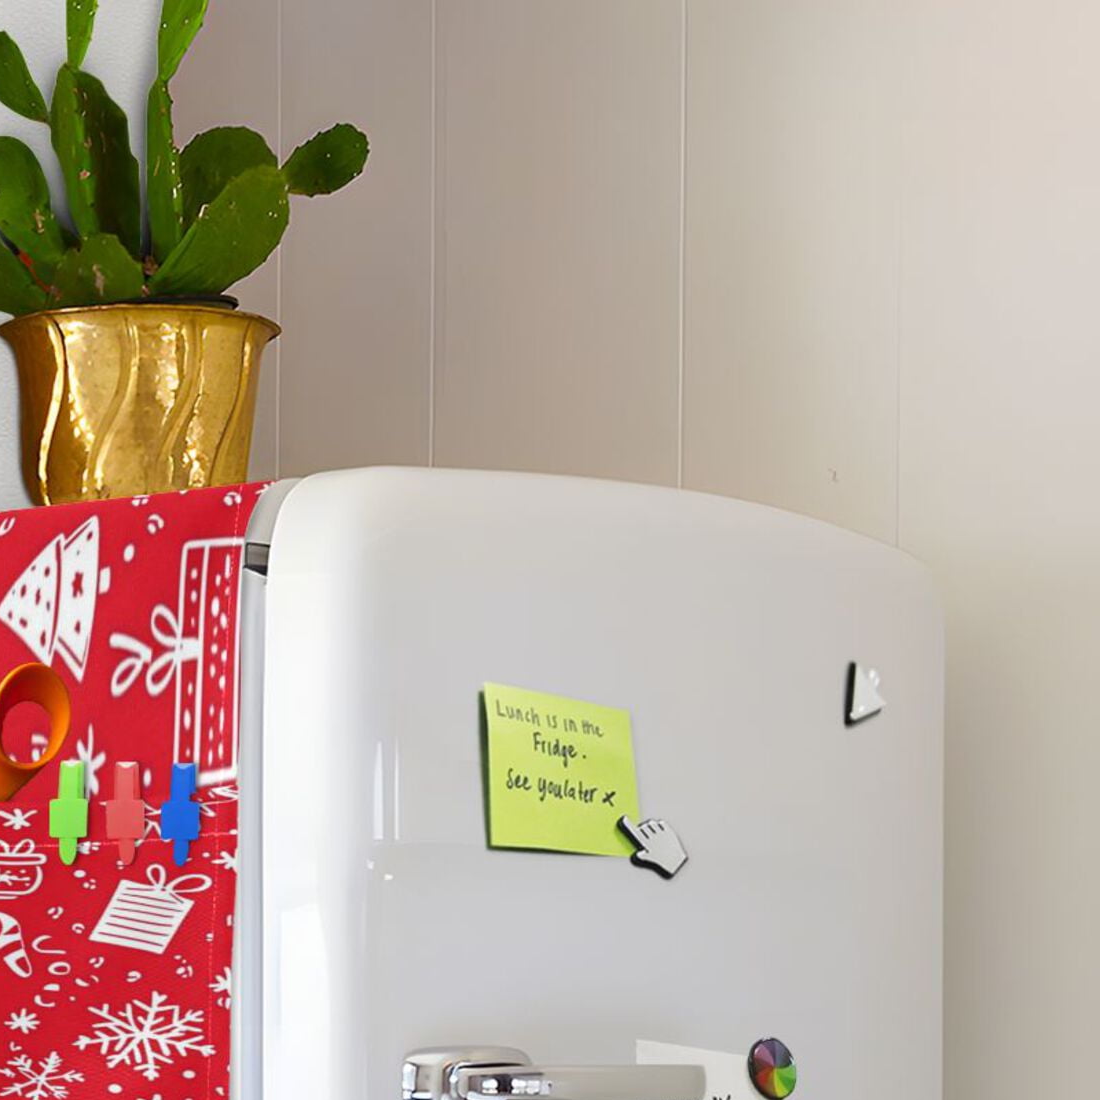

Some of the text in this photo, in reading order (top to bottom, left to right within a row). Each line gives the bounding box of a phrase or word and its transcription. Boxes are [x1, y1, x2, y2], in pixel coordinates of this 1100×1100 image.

[496, 700, 604, 738] Lunch is in the
[506, 768, 532, 791] See
